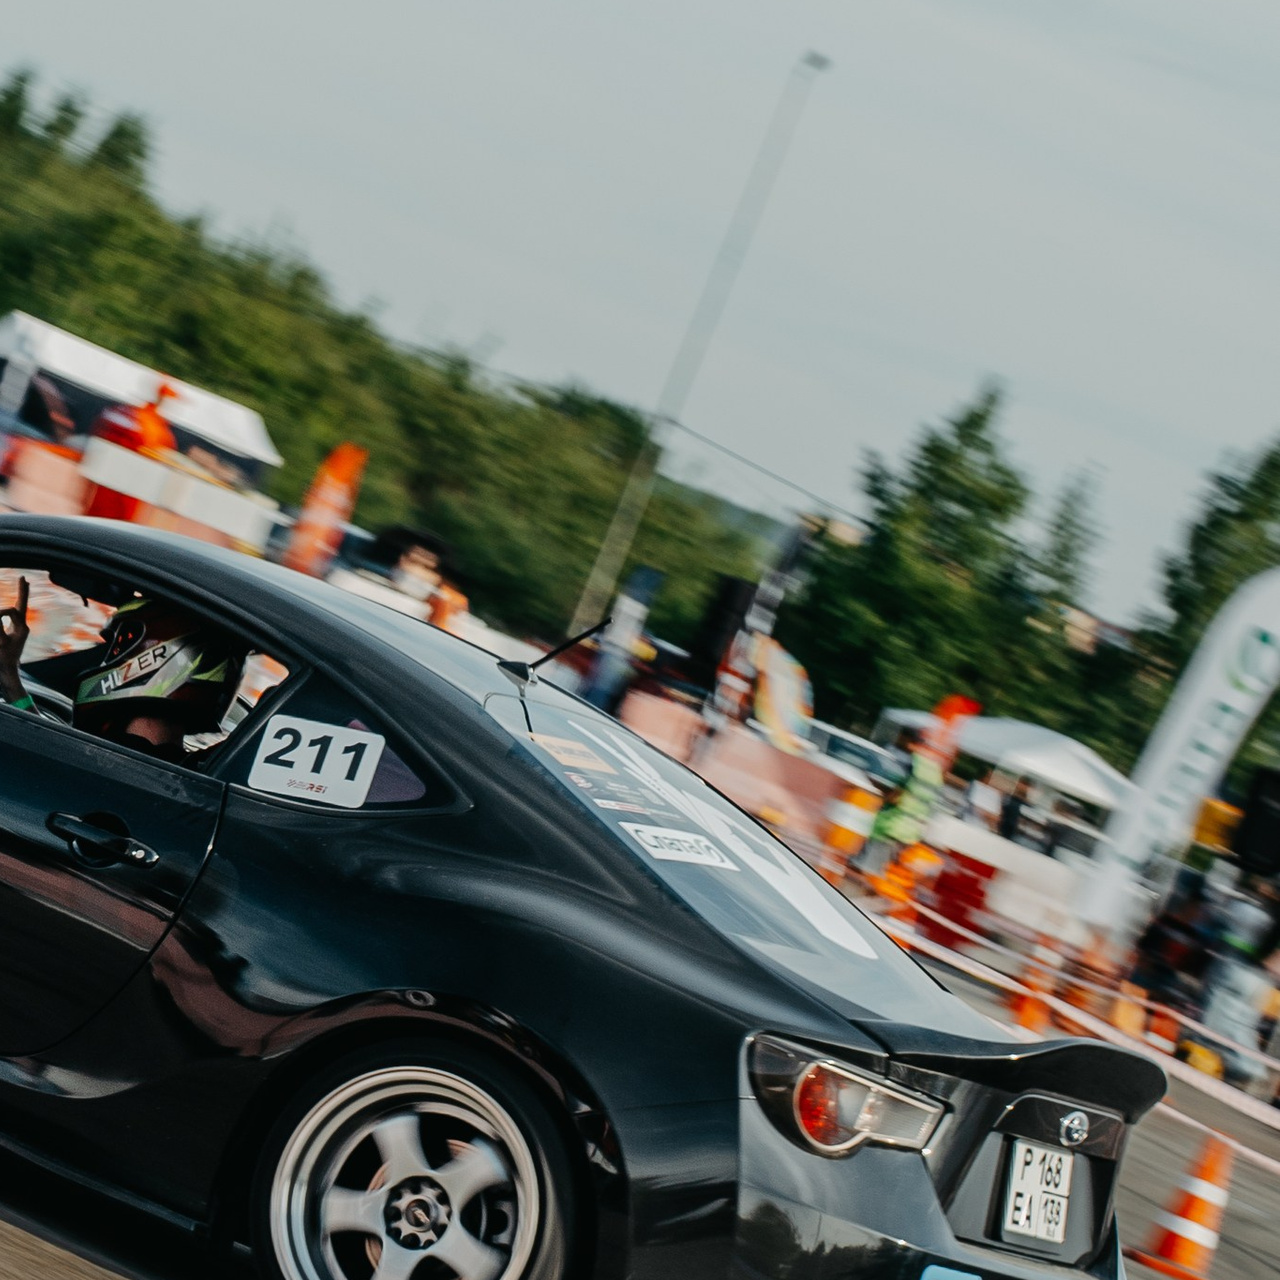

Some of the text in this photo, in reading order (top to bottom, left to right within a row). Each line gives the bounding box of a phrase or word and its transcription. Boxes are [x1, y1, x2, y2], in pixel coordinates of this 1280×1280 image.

[101, 645, 167, 695] HIZER
[263, 727, 368, 781] 211
[1039, 1152, 1063, 1188] 168
[1043, 1198, 1061, 1225] 138
